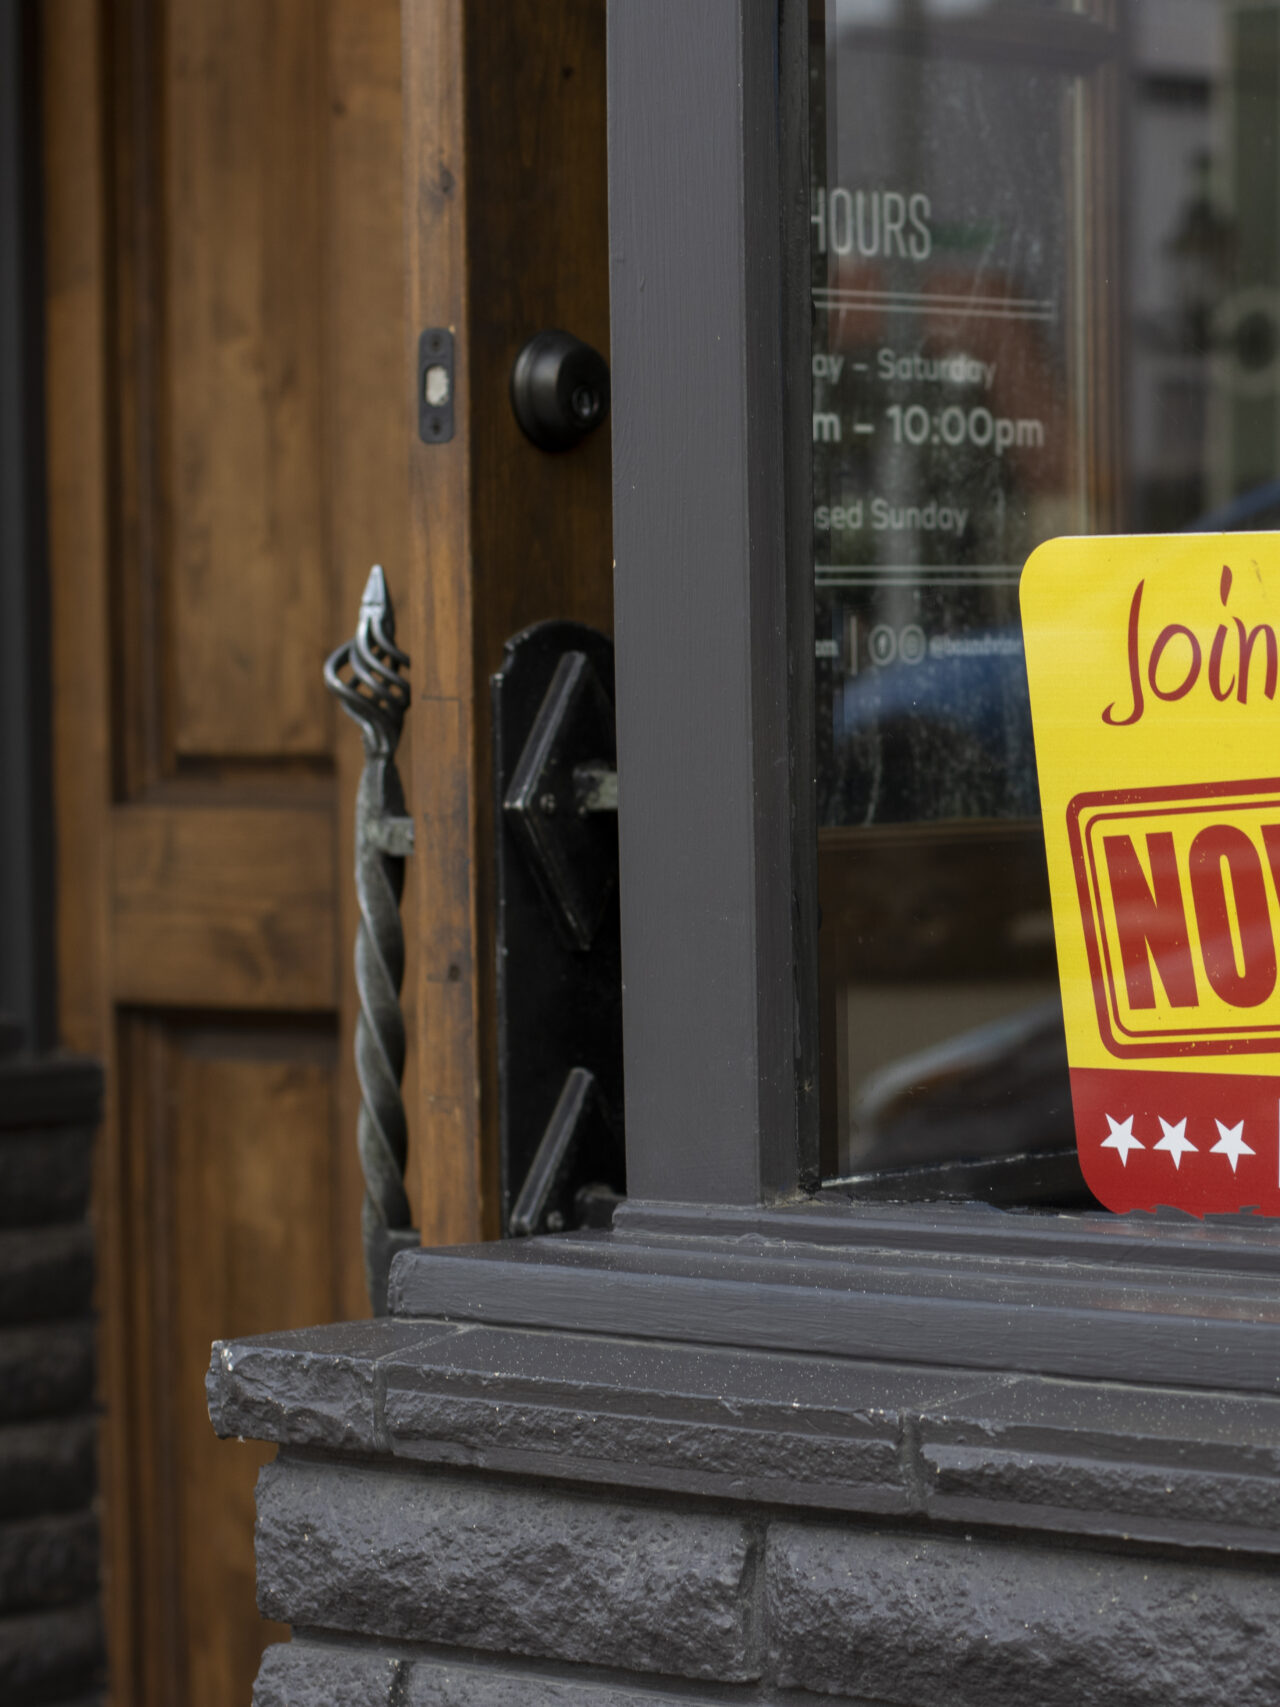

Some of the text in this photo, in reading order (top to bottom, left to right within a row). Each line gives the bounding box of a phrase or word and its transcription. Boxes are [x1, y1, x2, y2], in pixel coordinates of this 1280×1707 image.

[811, 186, 932, 261] HOURS
[811, 353, 845, 386] ay
[877, 348, 997, 389] Saturday
[811, 411, 843, 444] m
[886, 404, 1044, 455] 10:00pm
[814, 497, 968, 536] sed Sunday
[1101, 565, 1279, 726] Join
